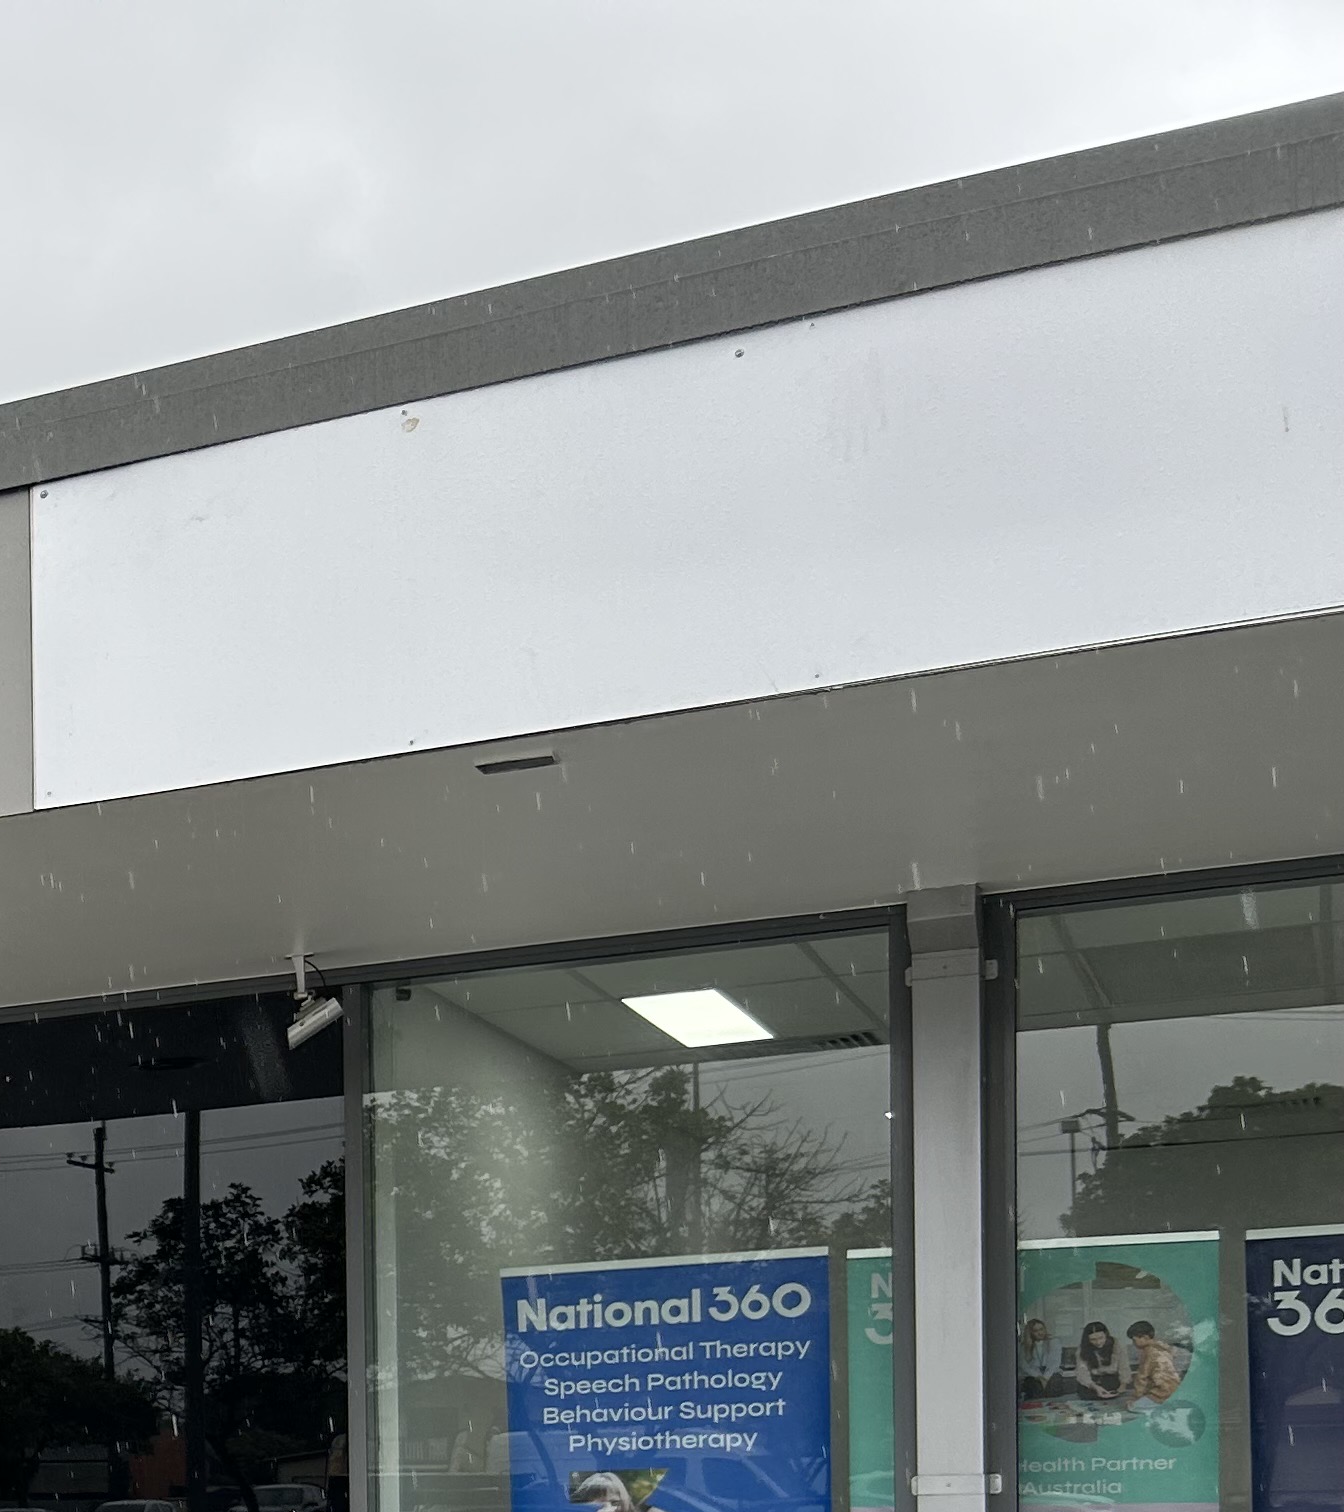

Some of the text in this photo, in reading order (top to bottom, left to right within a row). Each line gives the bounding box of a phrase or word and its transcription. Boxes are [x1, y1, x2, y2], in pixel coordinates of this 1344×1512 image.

[516, 1282, 812, 1333] National 360
[519, 1339, 811, 1370] Occupational Therapy
[544, 1369, 783, 1399] Speech Pathology
[543, 1398, 786, 1425] Behaviour Support
[568, 1431, 758, 1456] Physiotherapy
[1091, 1456, 1177, 1471] Partner
[1022, 1479, 1123, 1495] Australia
